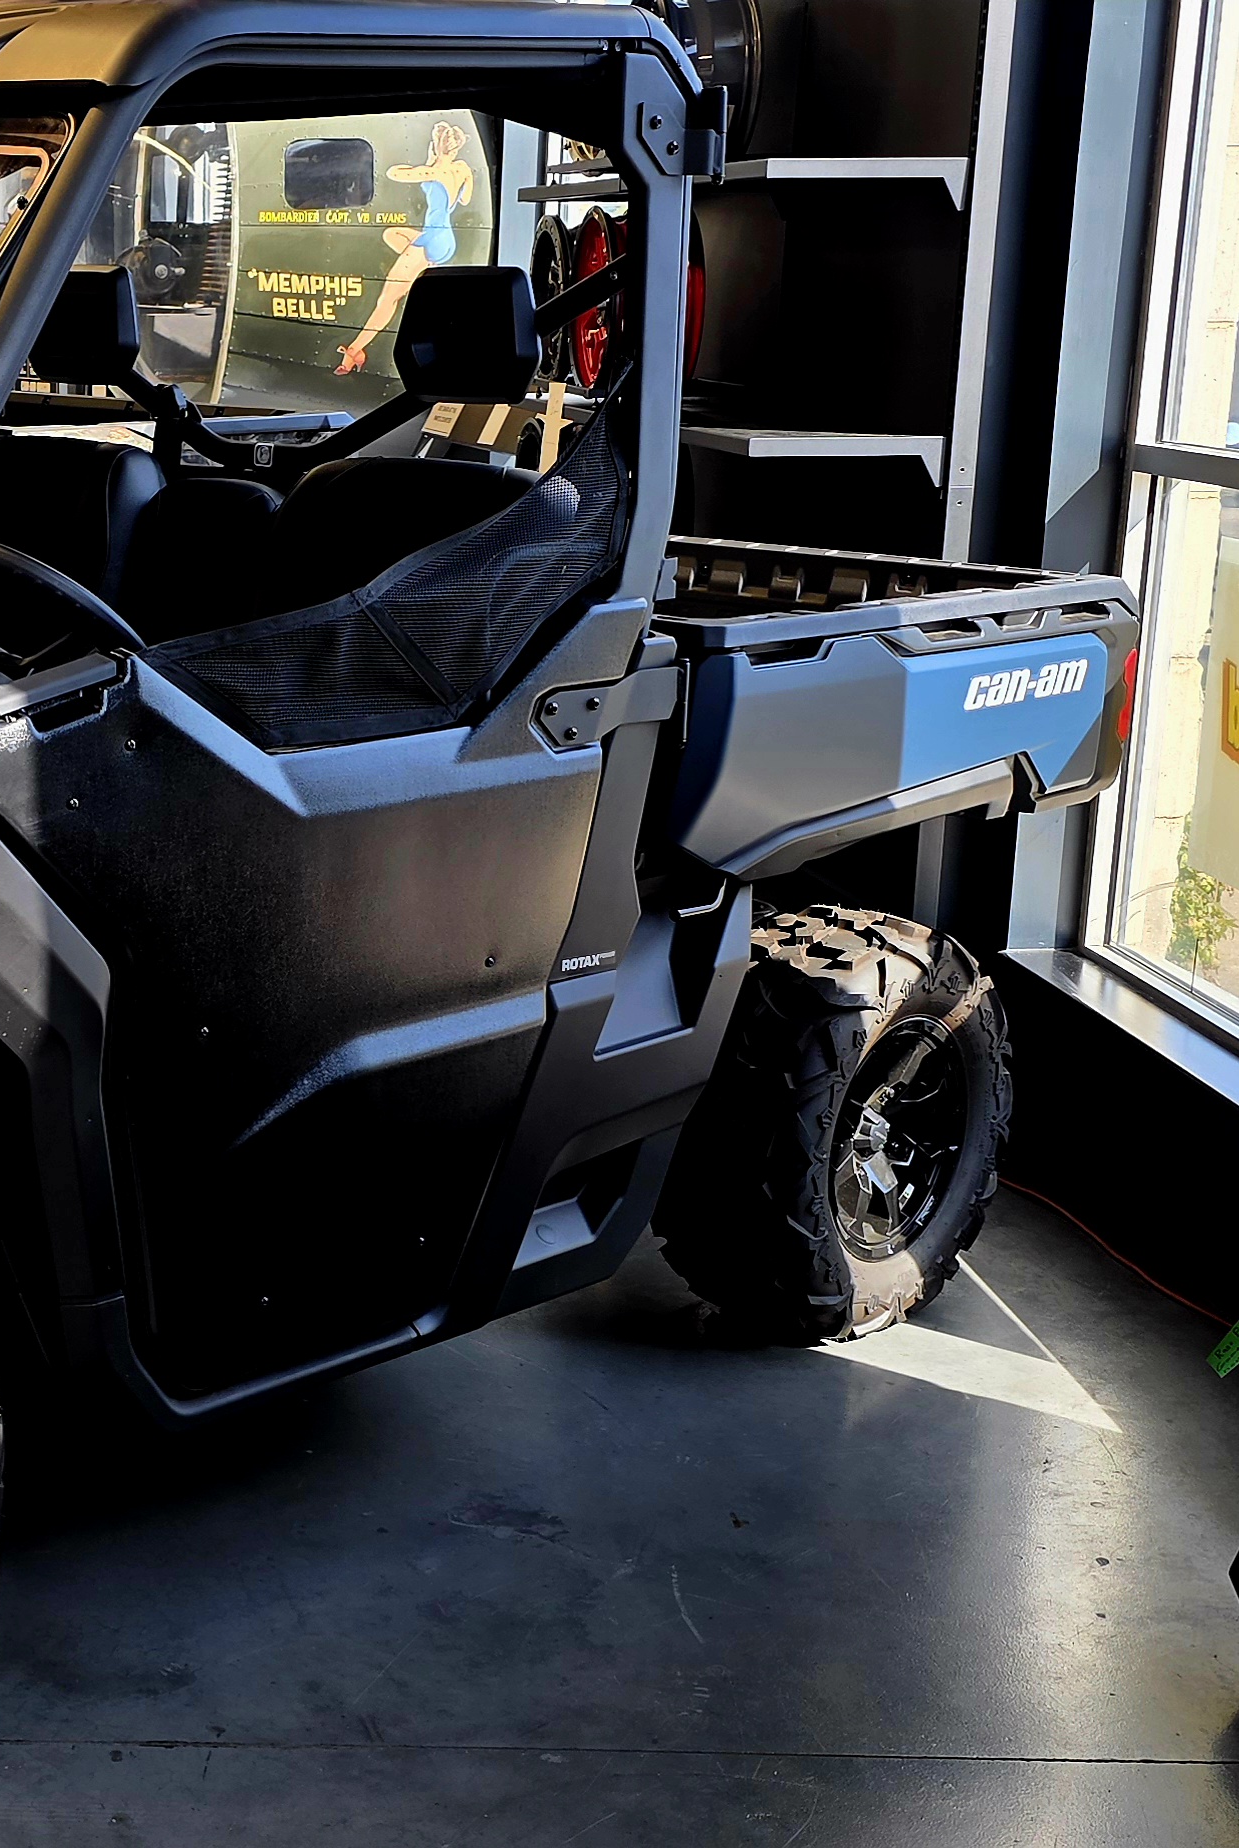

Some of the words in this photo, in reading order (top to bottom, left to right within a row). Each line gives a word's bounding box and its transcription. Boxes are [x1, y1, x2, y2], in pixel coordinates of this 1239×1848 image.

[375, 212, 407, 224] EVANS
[963, 658, 1089, 711] can-am
[561, 953, 600, 972] ROTAX
